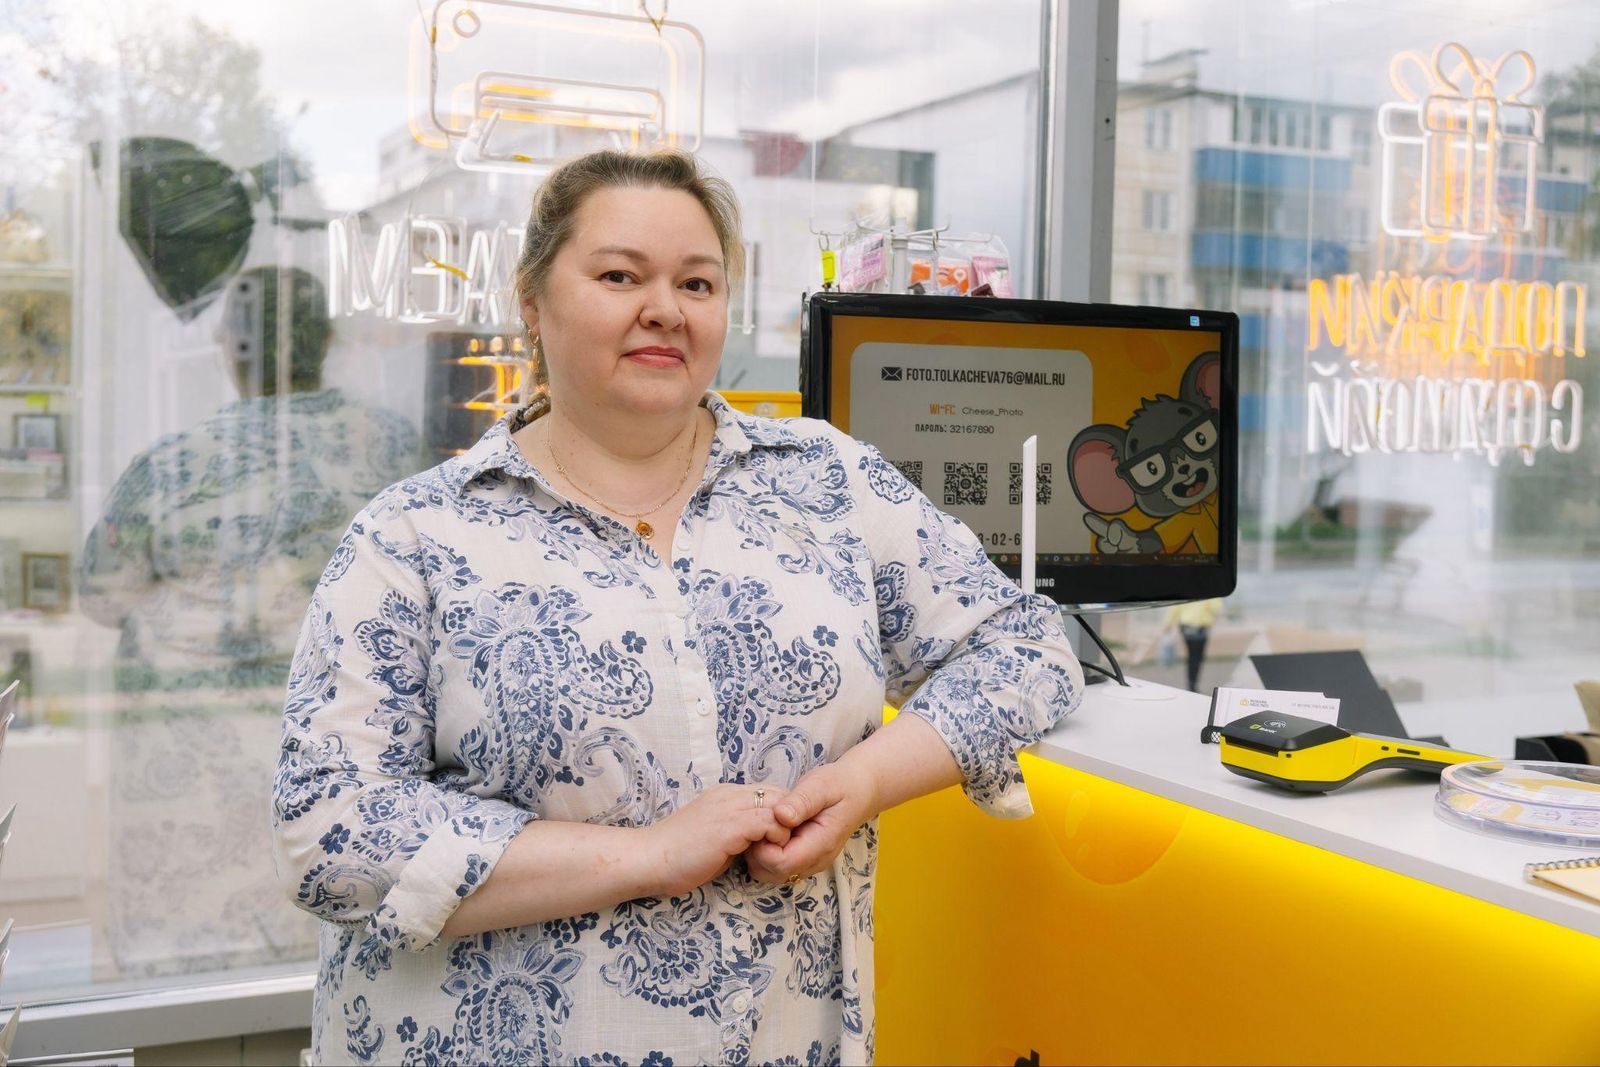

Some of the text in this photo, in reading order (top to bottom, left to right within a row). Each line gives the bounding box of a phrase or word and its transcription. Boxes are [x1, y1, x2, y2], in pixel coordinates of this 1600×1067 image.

[905, 367, 1066, 386] FOTO.TOLKACHEVA76@MAIL.RU
[961, 406, 1024, 417] Cheese_Photo
[914, 423, 995, 435] ПАРОЛЬ: 32167890
[977, 533, 1021, 546] 3-02-6
